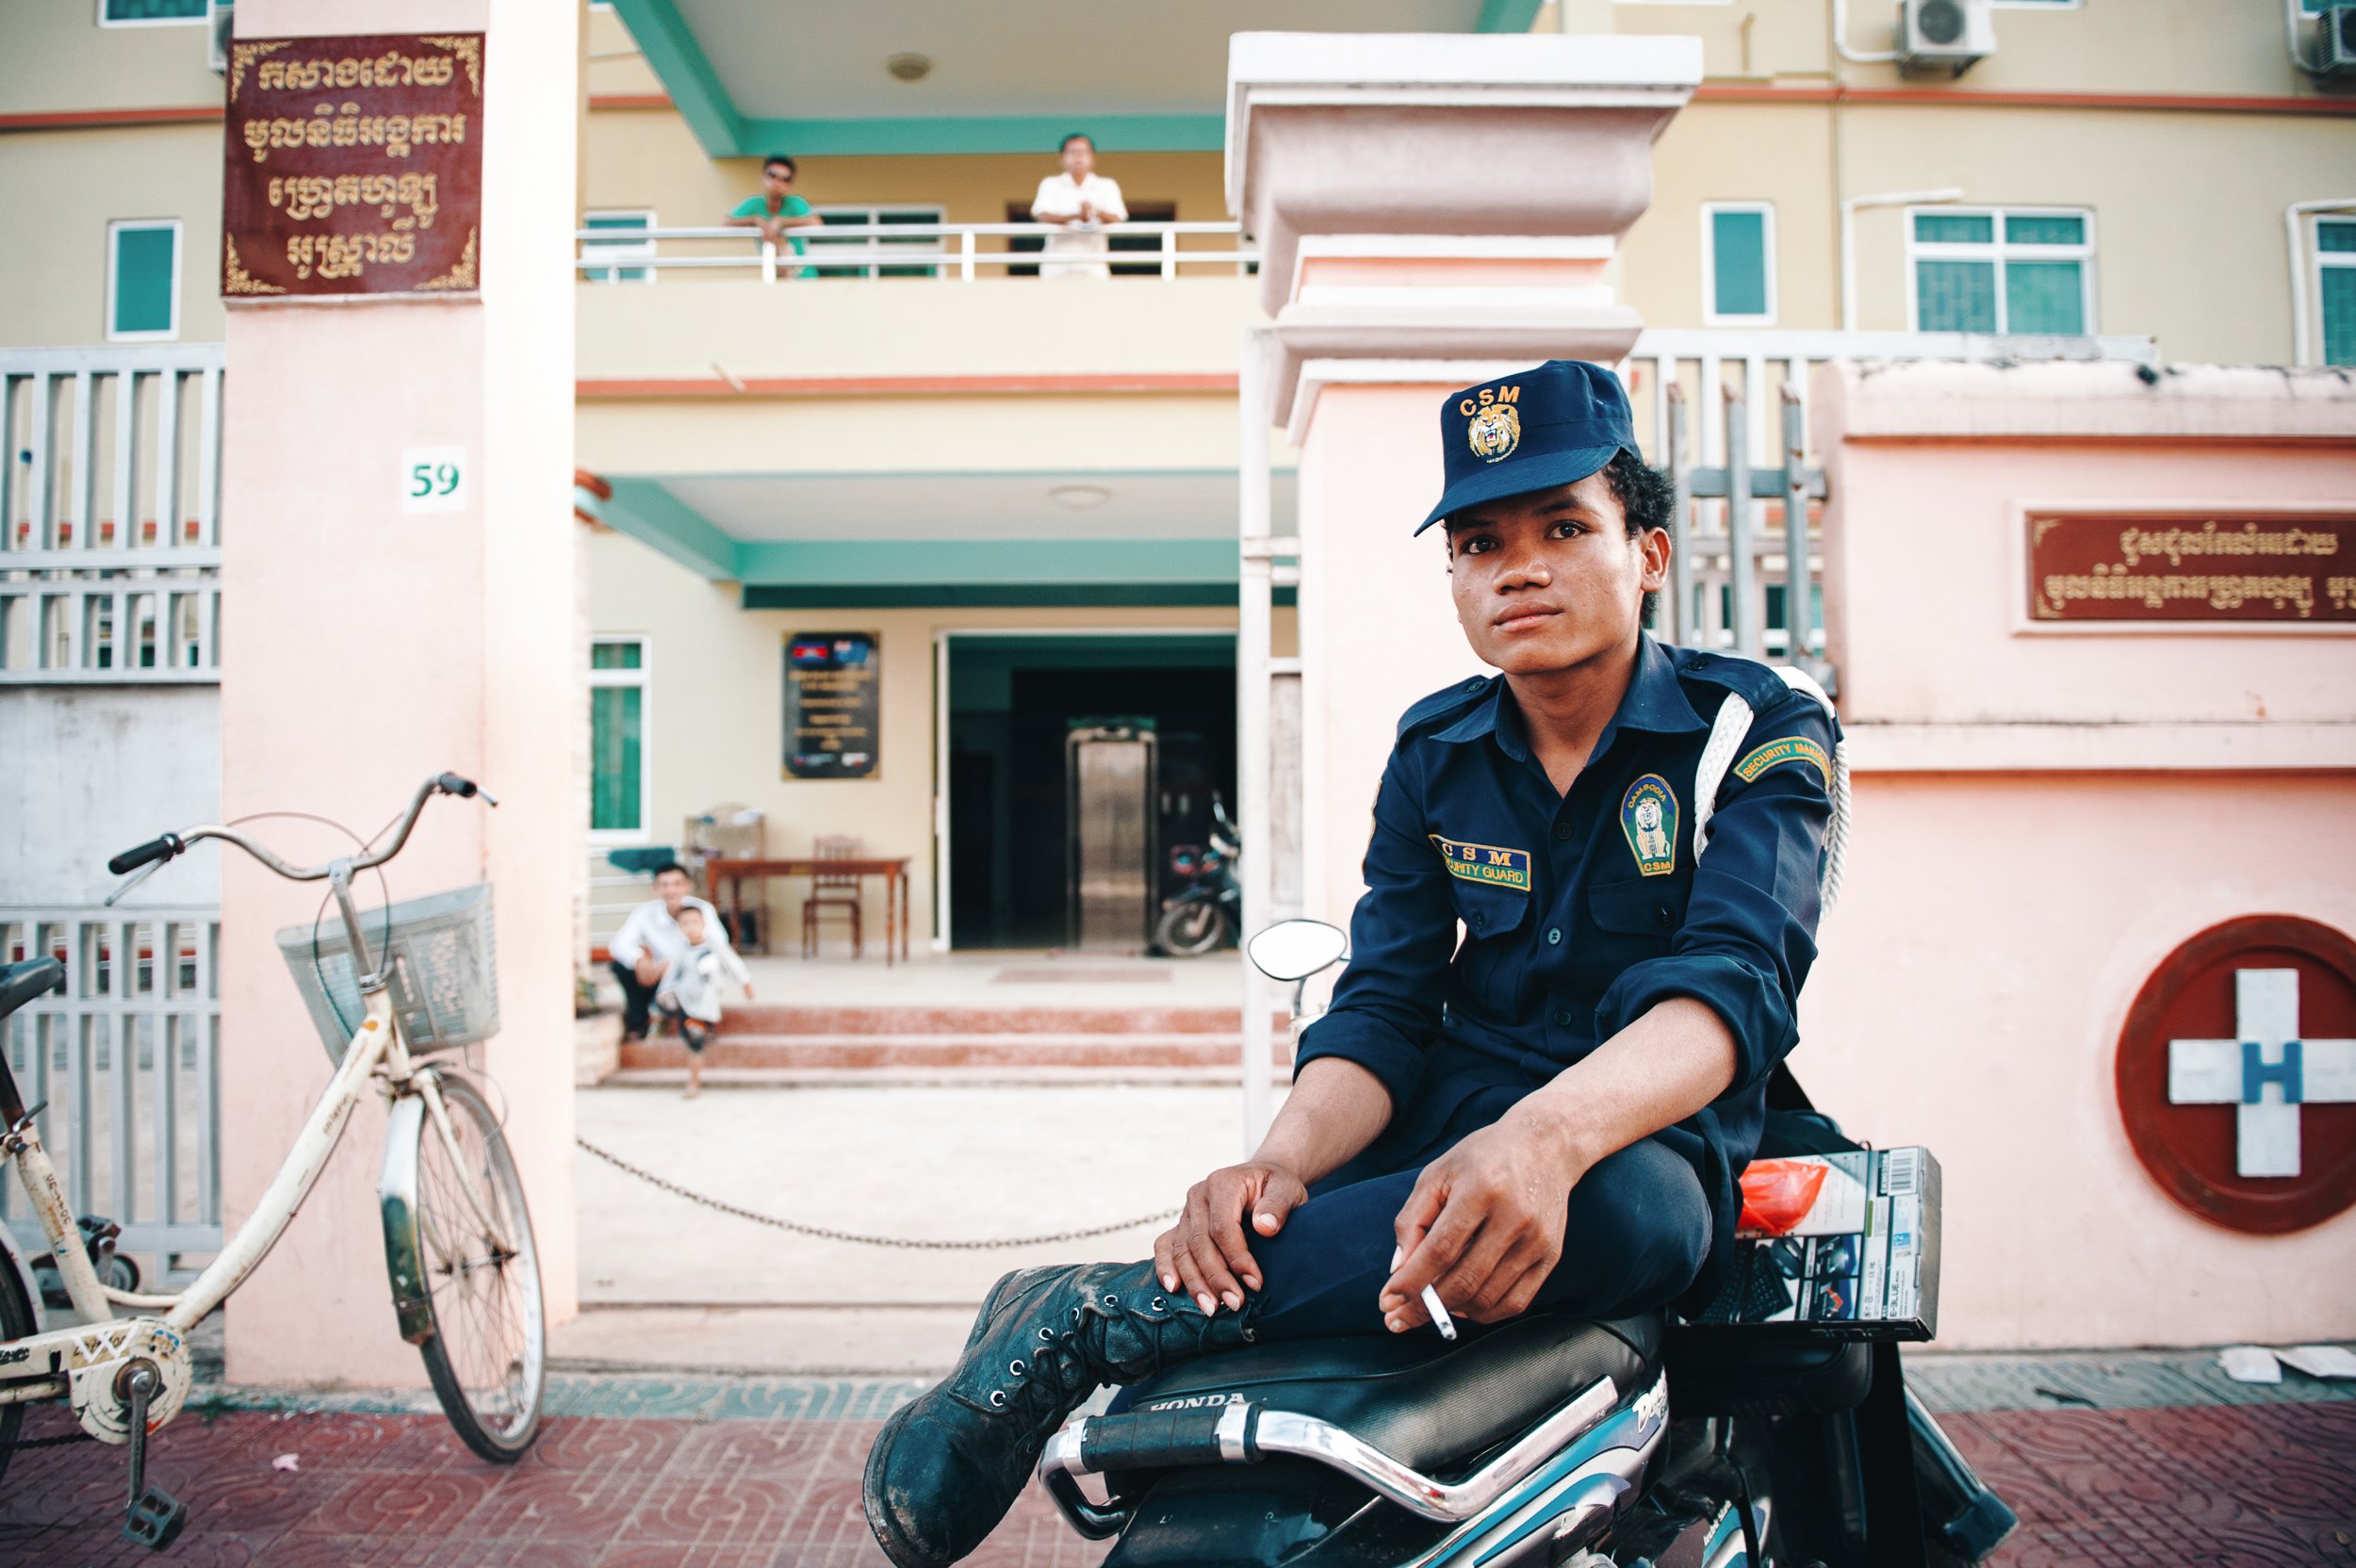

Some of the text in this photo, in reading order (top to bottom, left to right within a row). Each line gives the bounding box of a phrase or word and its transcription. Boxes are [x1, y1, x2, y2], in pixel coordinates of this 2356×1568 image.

[258, 51, 454, 90] កសាងដោយ
[244, 102, 466, 162] មូលនិធិអង្គការ
[1460, 385, 1520, 416] CSM
[411, 464, 459, 497] 59
[1743, 743, 1792, 777] SECURITY
[1482, 866, 1524, 883] GUARD
[1644, 861, 1670, 872] CSM
[2242, 1040, 2303, 1104] H
